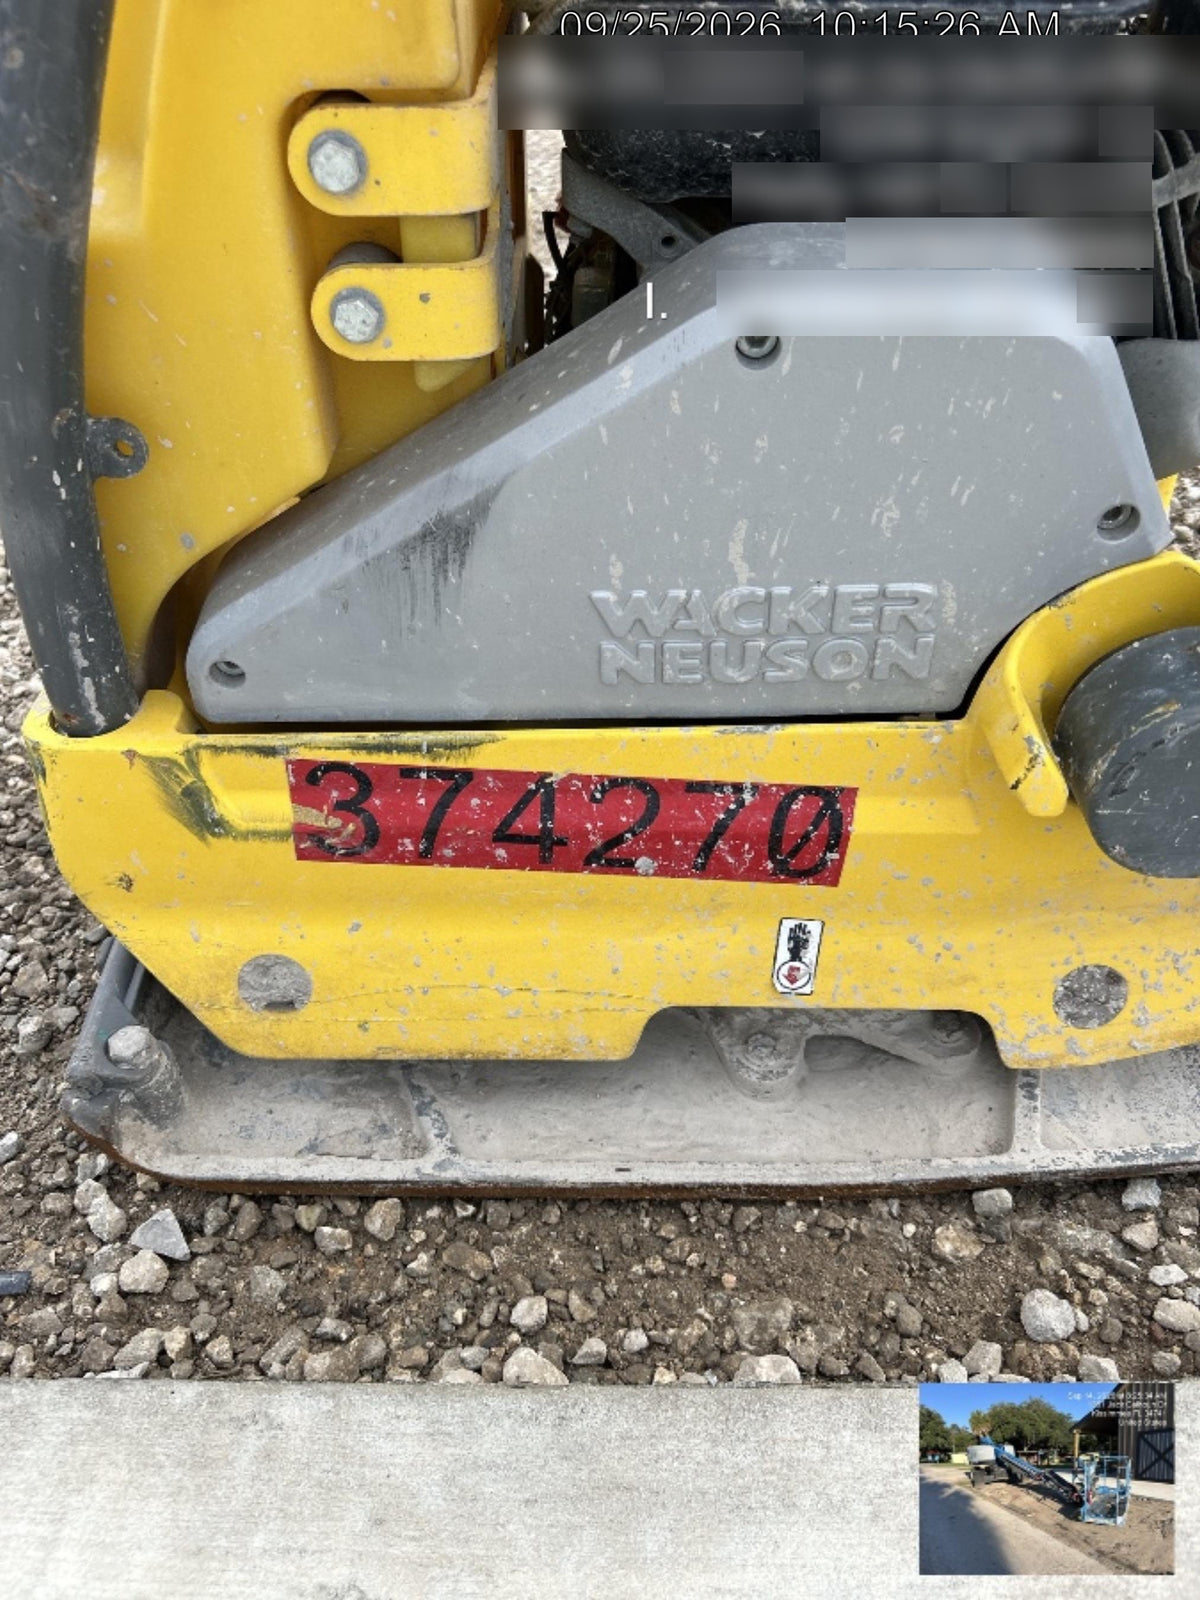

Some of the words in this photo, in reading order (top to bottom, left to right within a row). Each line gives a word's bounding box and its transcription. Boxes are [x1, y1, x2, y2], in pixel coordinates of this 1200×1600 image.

[589, 582, 938, 638] WACKER
[599, 633, 936, 685] NEUSON
[304, 760, 846, 879] 374270
